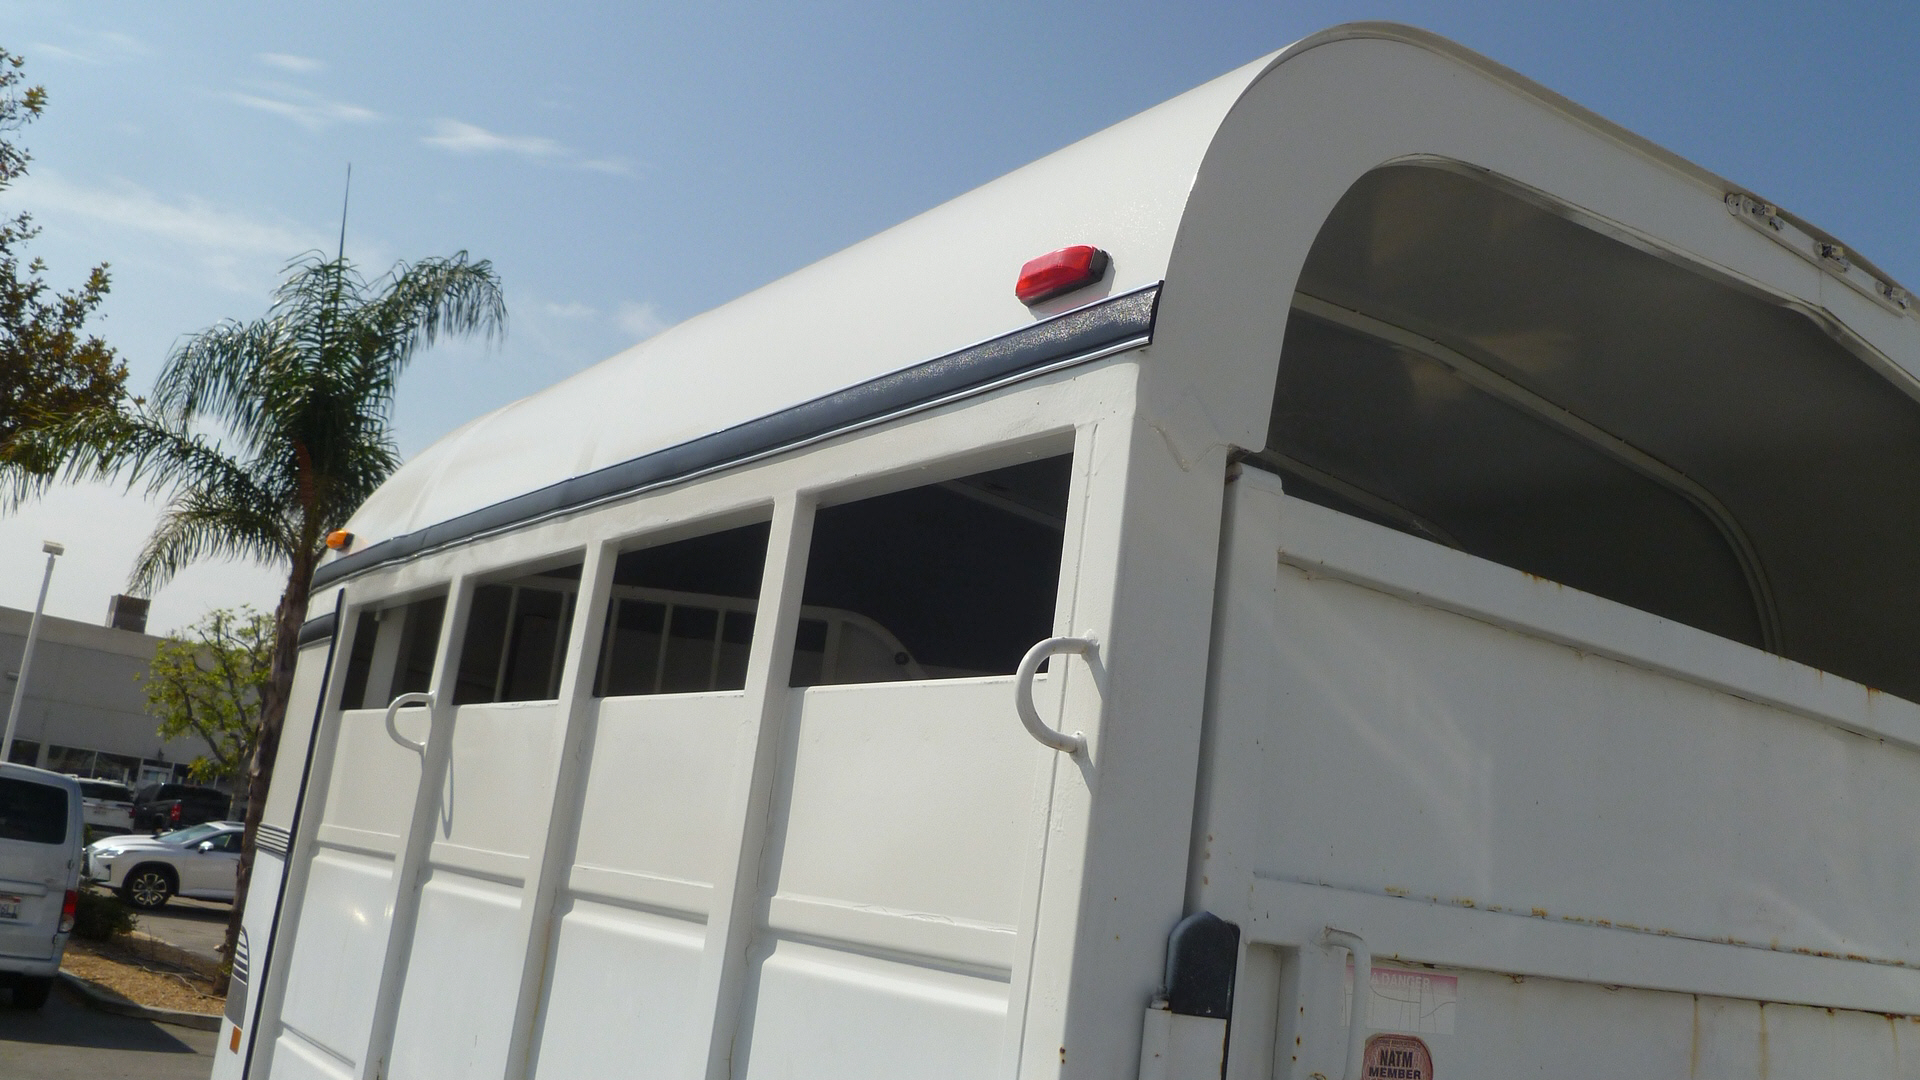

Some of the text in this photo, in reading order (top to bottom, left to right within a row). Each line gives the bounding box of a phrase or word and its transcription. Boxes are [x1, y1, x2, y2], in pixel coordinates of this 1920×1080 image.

[1381, 973, 1430, 992] DANGER
[1381, 1049, 1412, 1067] NATM
[1369, 1067, 1421, 1080] MEMBER
